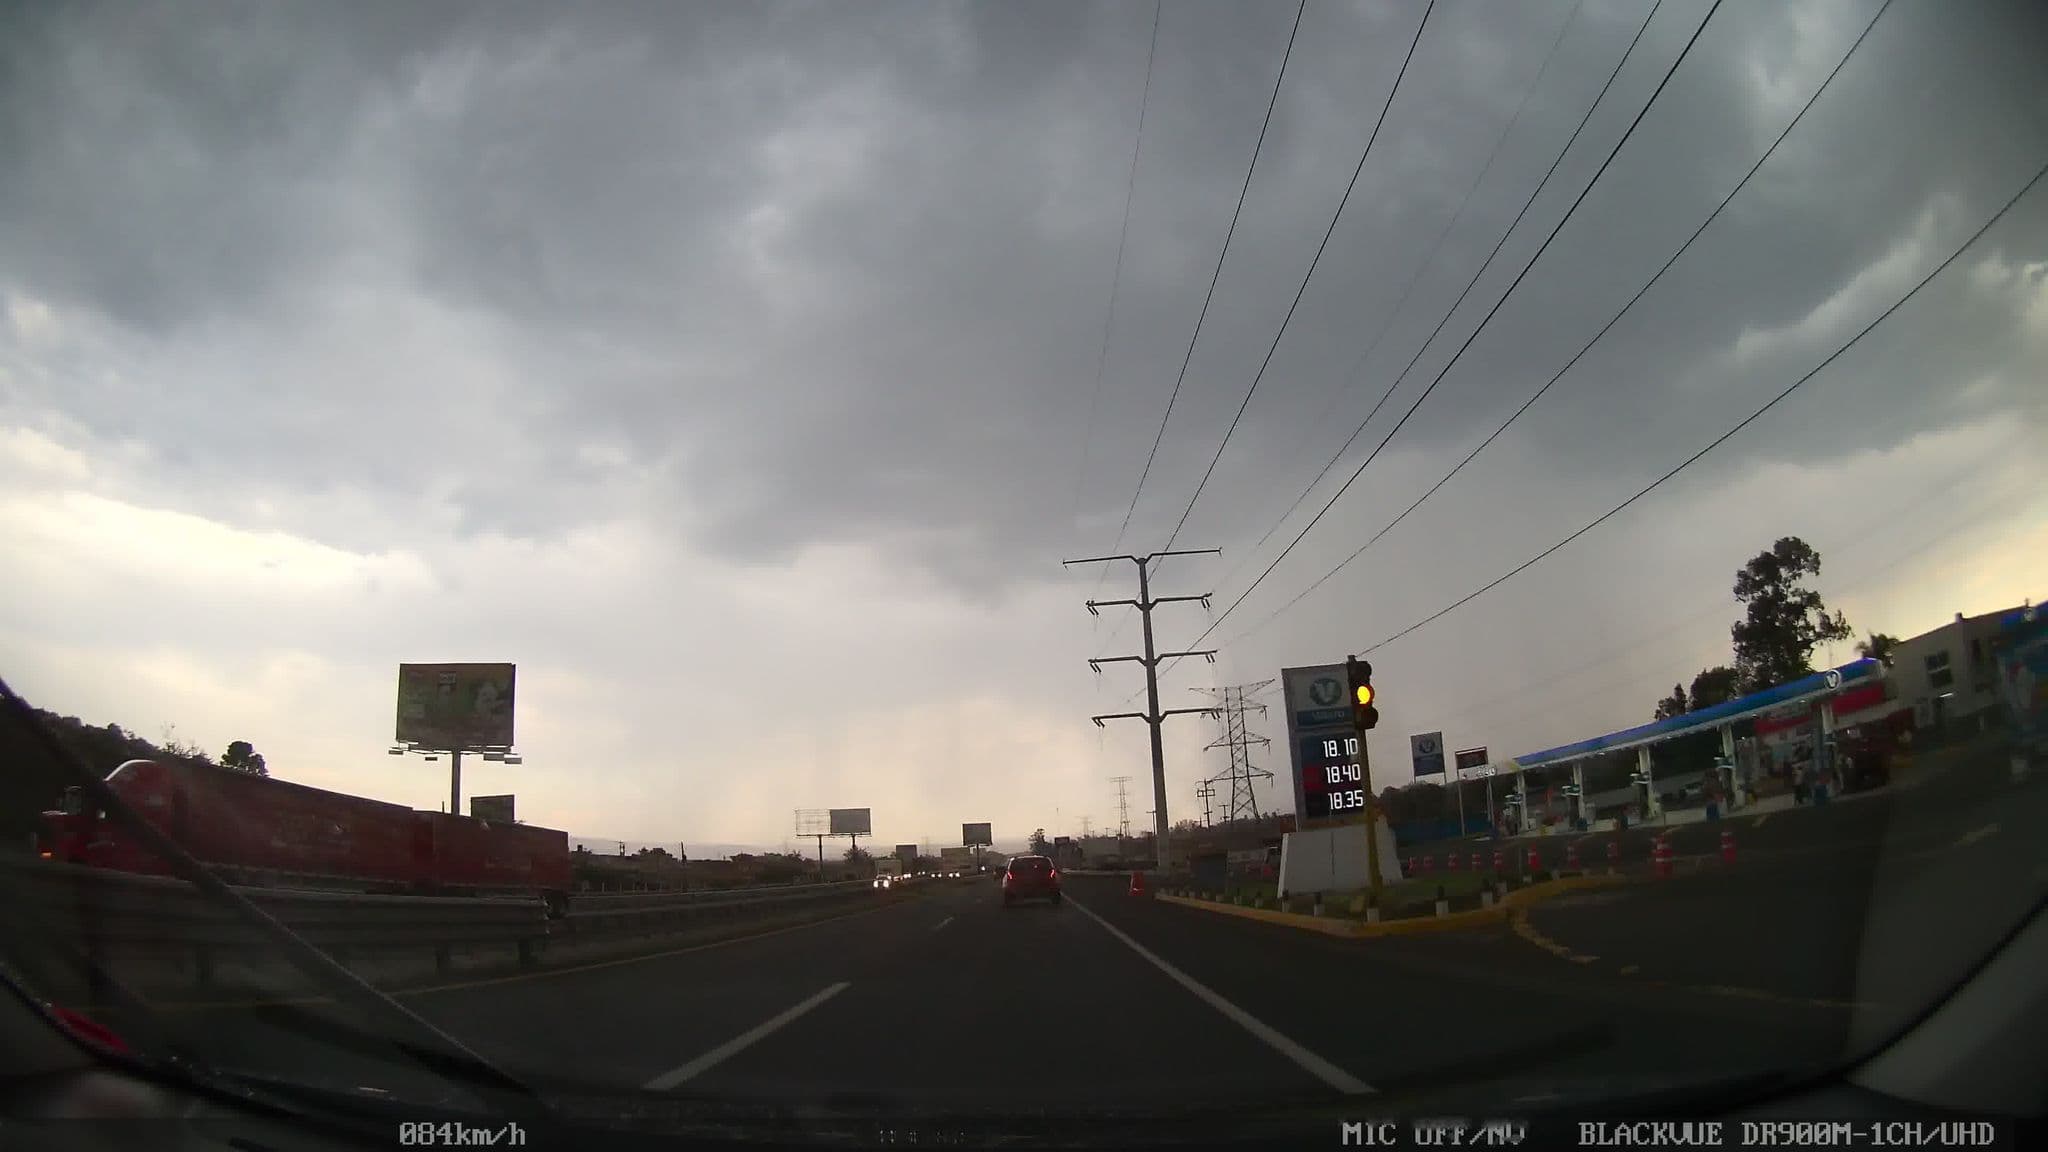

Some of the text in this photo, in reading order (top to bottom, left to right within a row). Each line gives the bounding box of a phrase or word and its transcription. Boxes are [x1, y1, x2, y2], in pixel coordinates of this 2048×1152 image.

[1323, 738, 1358, 758] 18.10
[1326, 764, 1361, 784] 18.40
[1328, 789, 1364, 810] 18.35
